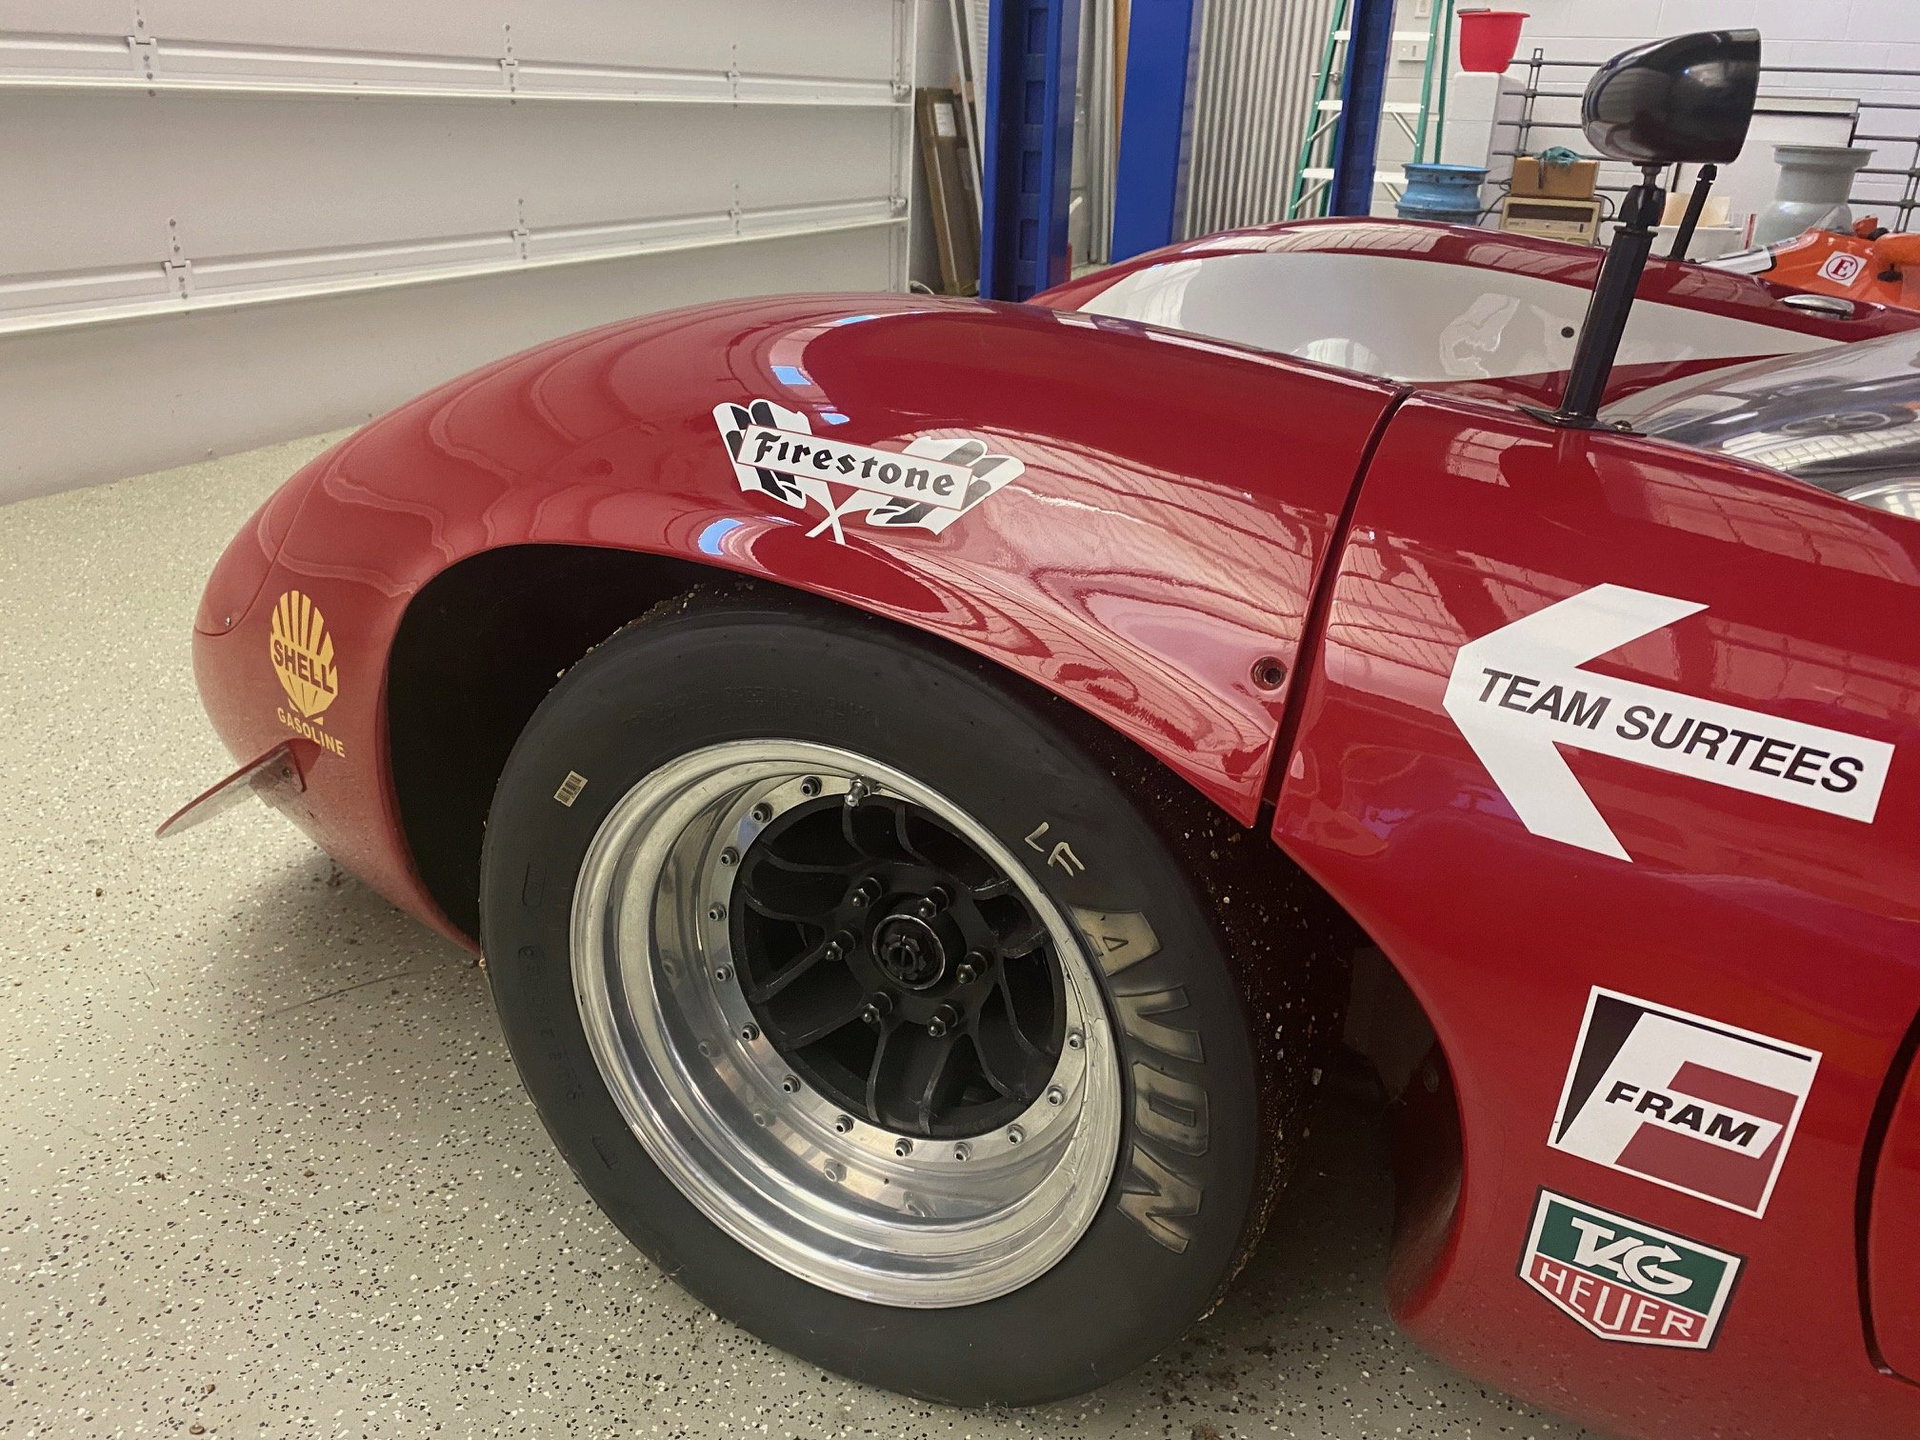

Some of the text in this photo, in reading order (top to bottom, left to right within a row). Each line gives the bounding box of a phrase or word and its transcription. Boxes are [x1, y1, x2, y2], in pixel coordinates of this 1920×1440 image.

[1832, 259, 1853, 277] E
[754, 431, 955, 497] Firestone
[274, 639, 334, 694] SHELL
[277, 707, 345, 758] GASOLINE
[1478, 667, 1865, 794] TEAM SURTEES
[1072, 906, 1209, 1254] AVON
[1605, 1080, 1760, 1148] FRAM
[1570, 1216, 1693, 1296] TAG
[1539, 1262, 1696, 1337] HEUER
